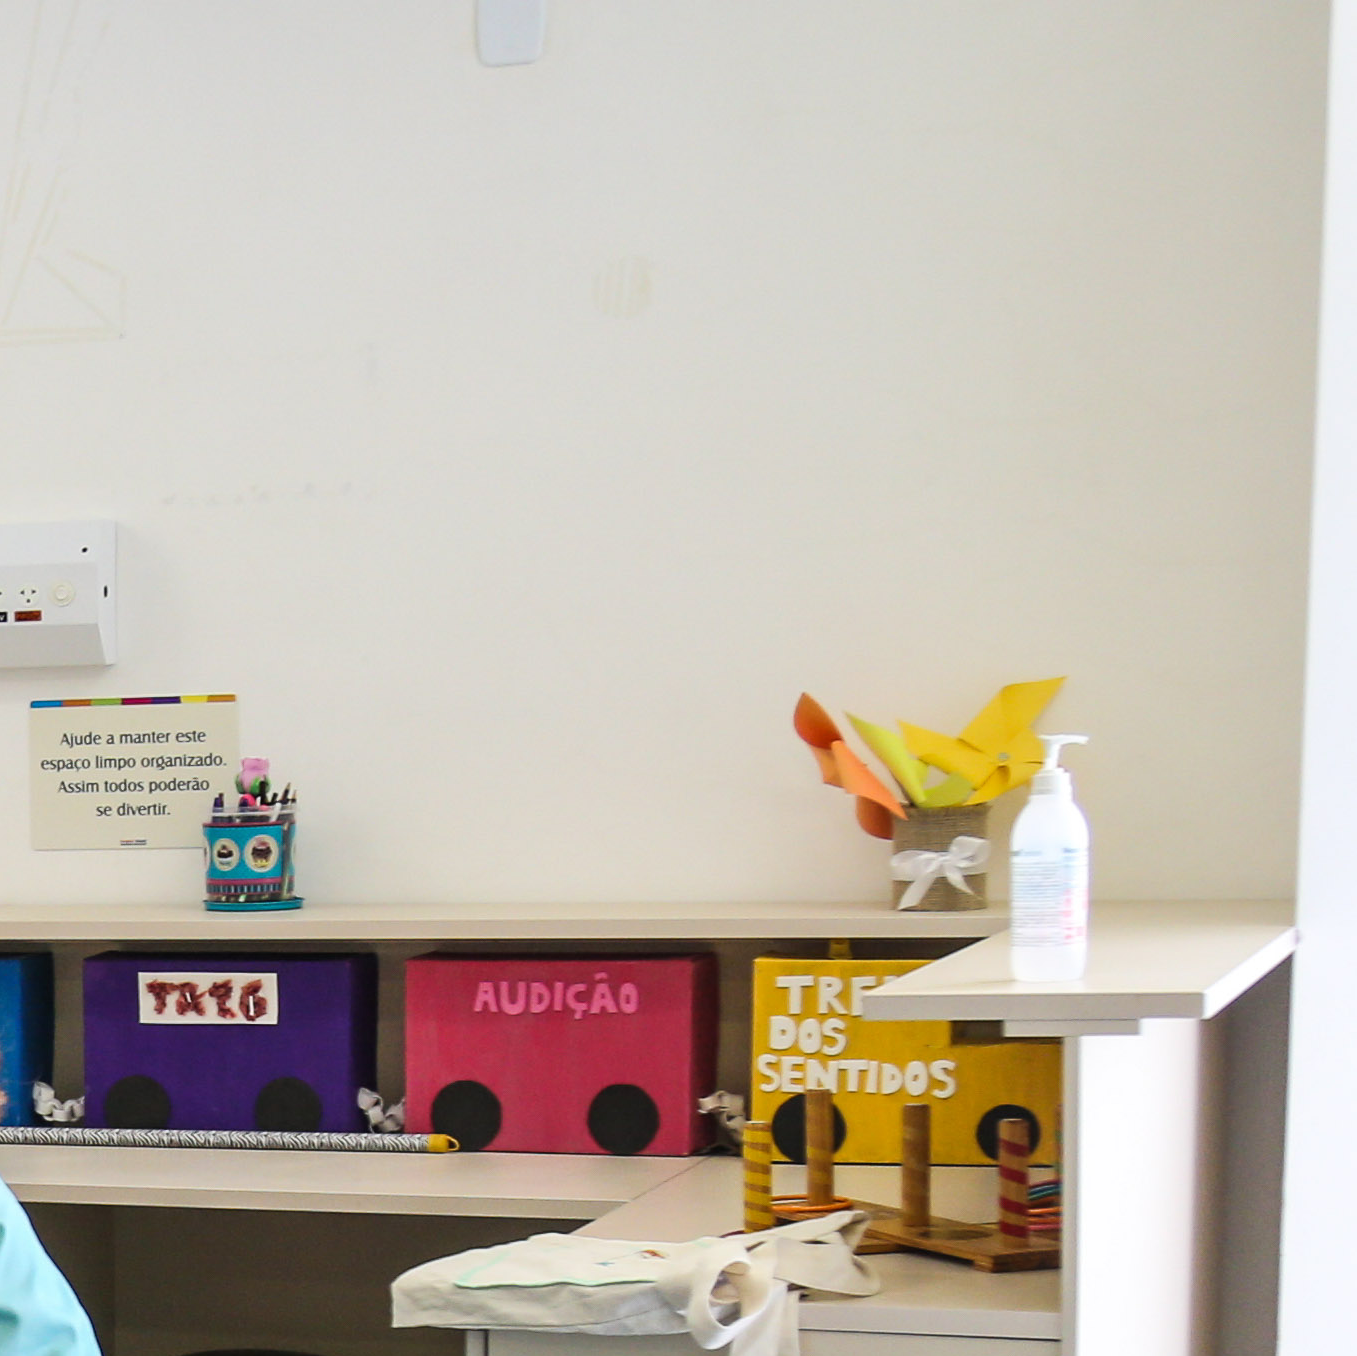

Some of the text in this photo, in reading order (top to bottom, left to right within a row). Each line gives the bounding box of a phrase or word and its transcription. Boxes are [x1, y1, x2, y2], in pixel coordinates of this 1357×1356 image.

[60, 730, 207, 748] Ajude a manter este
[40, 752, 228, 773] espaço limpo organizado.
[58, 776, 210, 794] Assim todos poderão
[96, 802, 171, 817] se divertir.
[473, 972, 639, 1020] AUDIÇÃO
[768, 1014, 848, 1056] DOS
[756, 1053, 958, 1099] SENTIDOS
